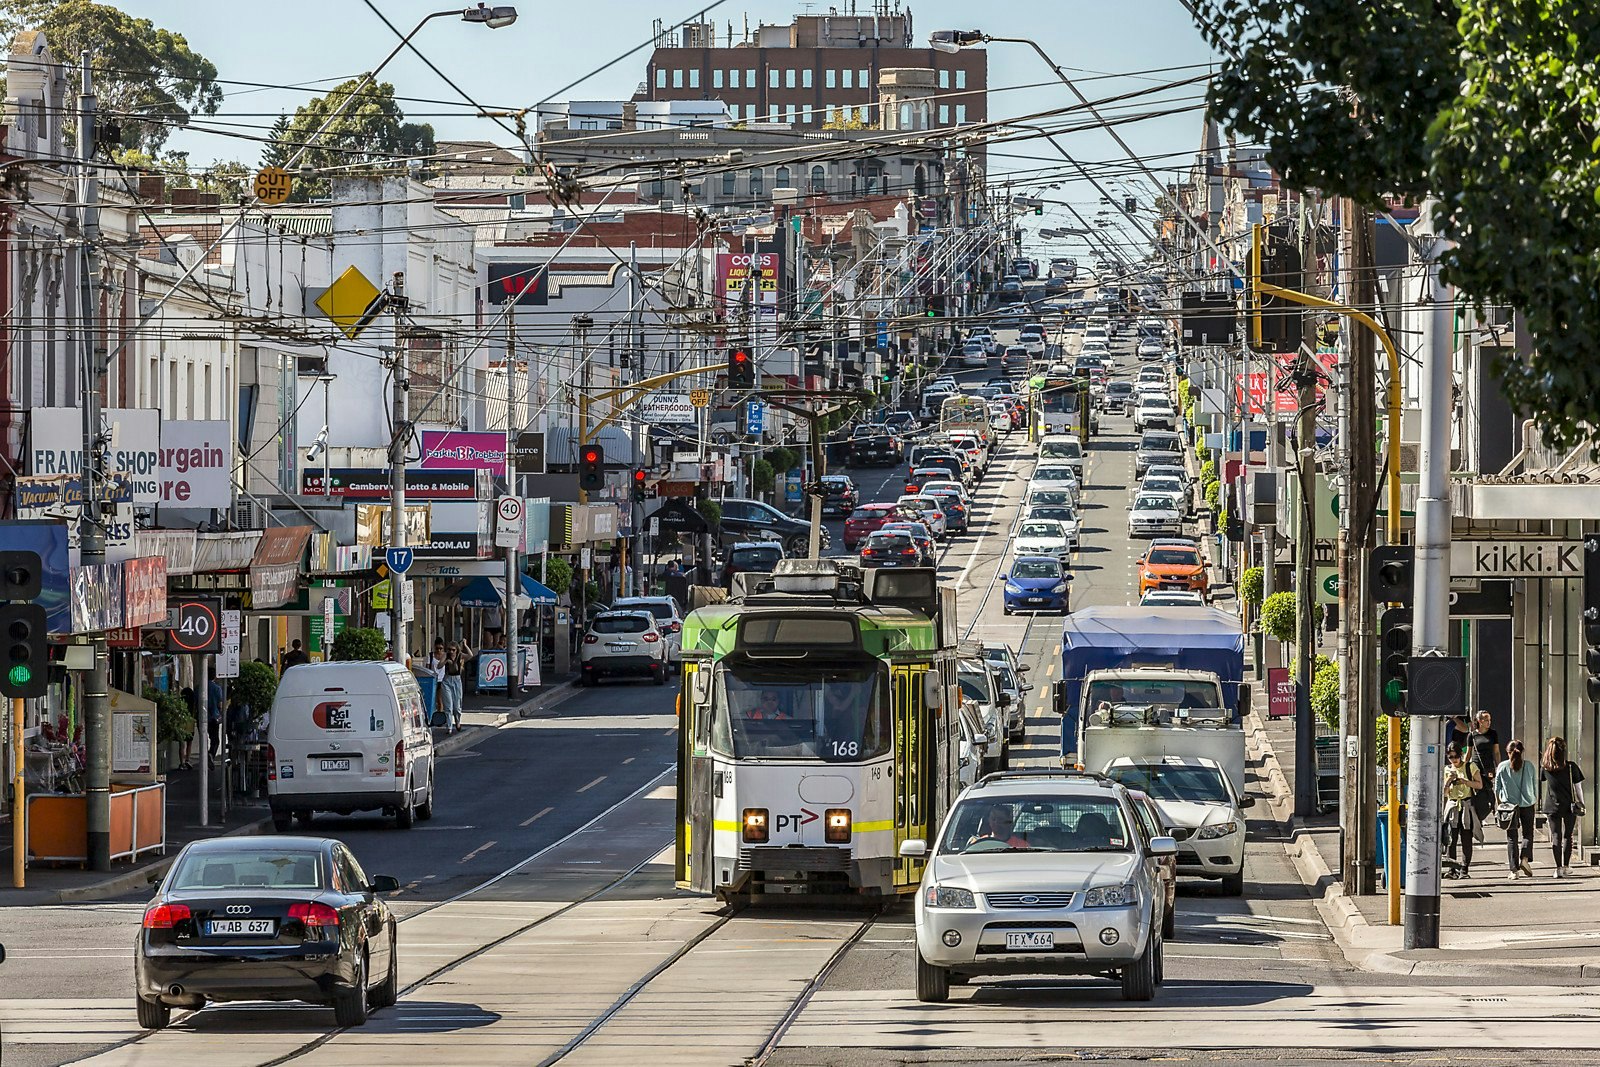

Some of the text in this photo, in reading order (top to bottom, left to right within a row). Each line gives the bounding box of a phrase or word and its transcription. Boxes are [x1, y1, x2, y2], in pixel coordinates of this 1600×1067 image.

[257, 173, 288, 186] CUT
[257, 187, 287, 200] OFF
[643, 404, 694, 412] EATHERGOODS
[426, 448, 456, 457] baskin
[475, 450, 505, 459] robbins
[116, 451, 157, 475] SHOP
[405, 482, 429, 491] Lotto
[440, 482, 470, 491] Mobile
[666, 484, 688, 493] UGG
[502, 504, 518, 514] 40
[392, 551, 408, 565] 17
[1475, 545, 1579, 572] kikki.K
[438, 565, 460, 574] Tatts
[179, 615, 209, 636] 40
[831, 740, 858, 757] 168
[249, 921, 270, 933] 637
[1008, 934, 1052, 945] TFX 664
